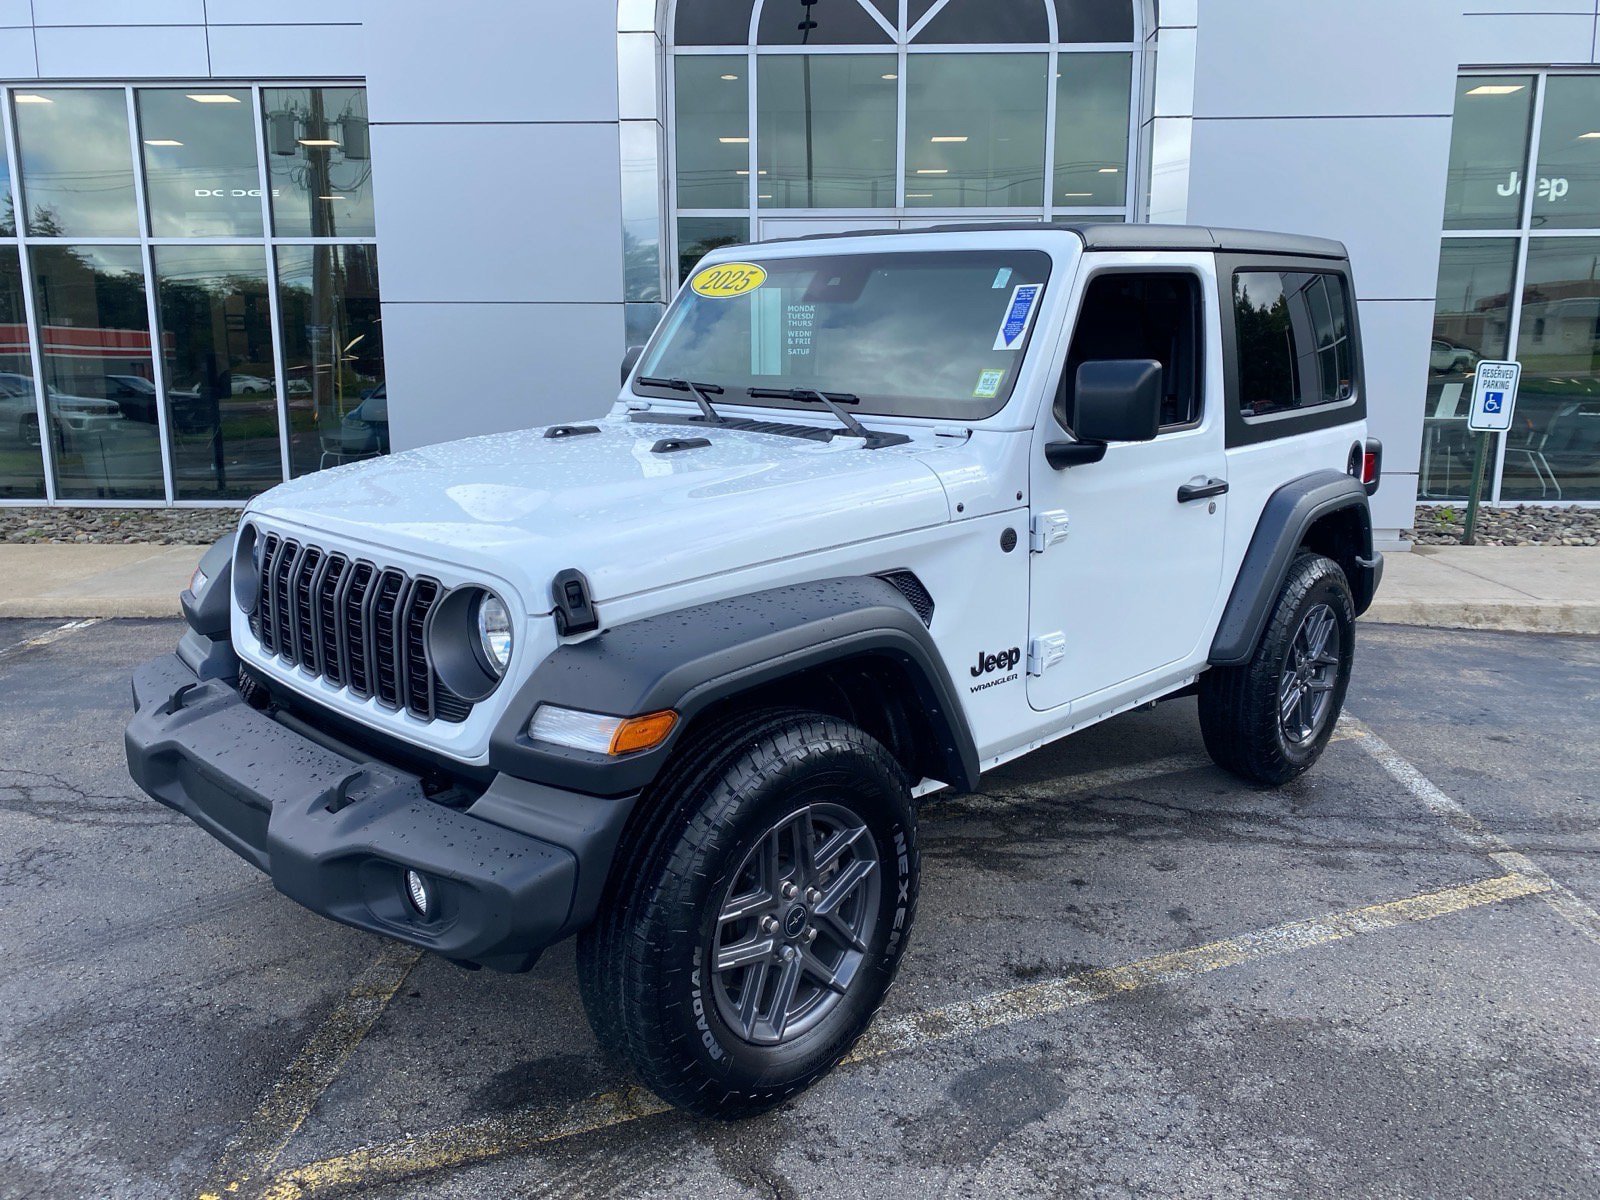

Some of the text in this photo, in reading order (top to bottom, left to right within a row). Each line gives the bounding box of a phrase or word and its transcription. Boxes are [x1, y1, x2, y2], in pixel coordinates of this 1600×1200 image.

[1497, 171, 1569, 201] Jep
[699, 270, 758, 291] 2025
[1482, 368, 1514, 379] RESERVED
[1482, 379, 1510, 390] PARKING
[970, 647, 1020, 677] Jeep
[970, 673, 1018, 693] WRANGLER
[886, 831, 909, 955] NEXEN
[691, 946, 724, 1061] ROADIAN
